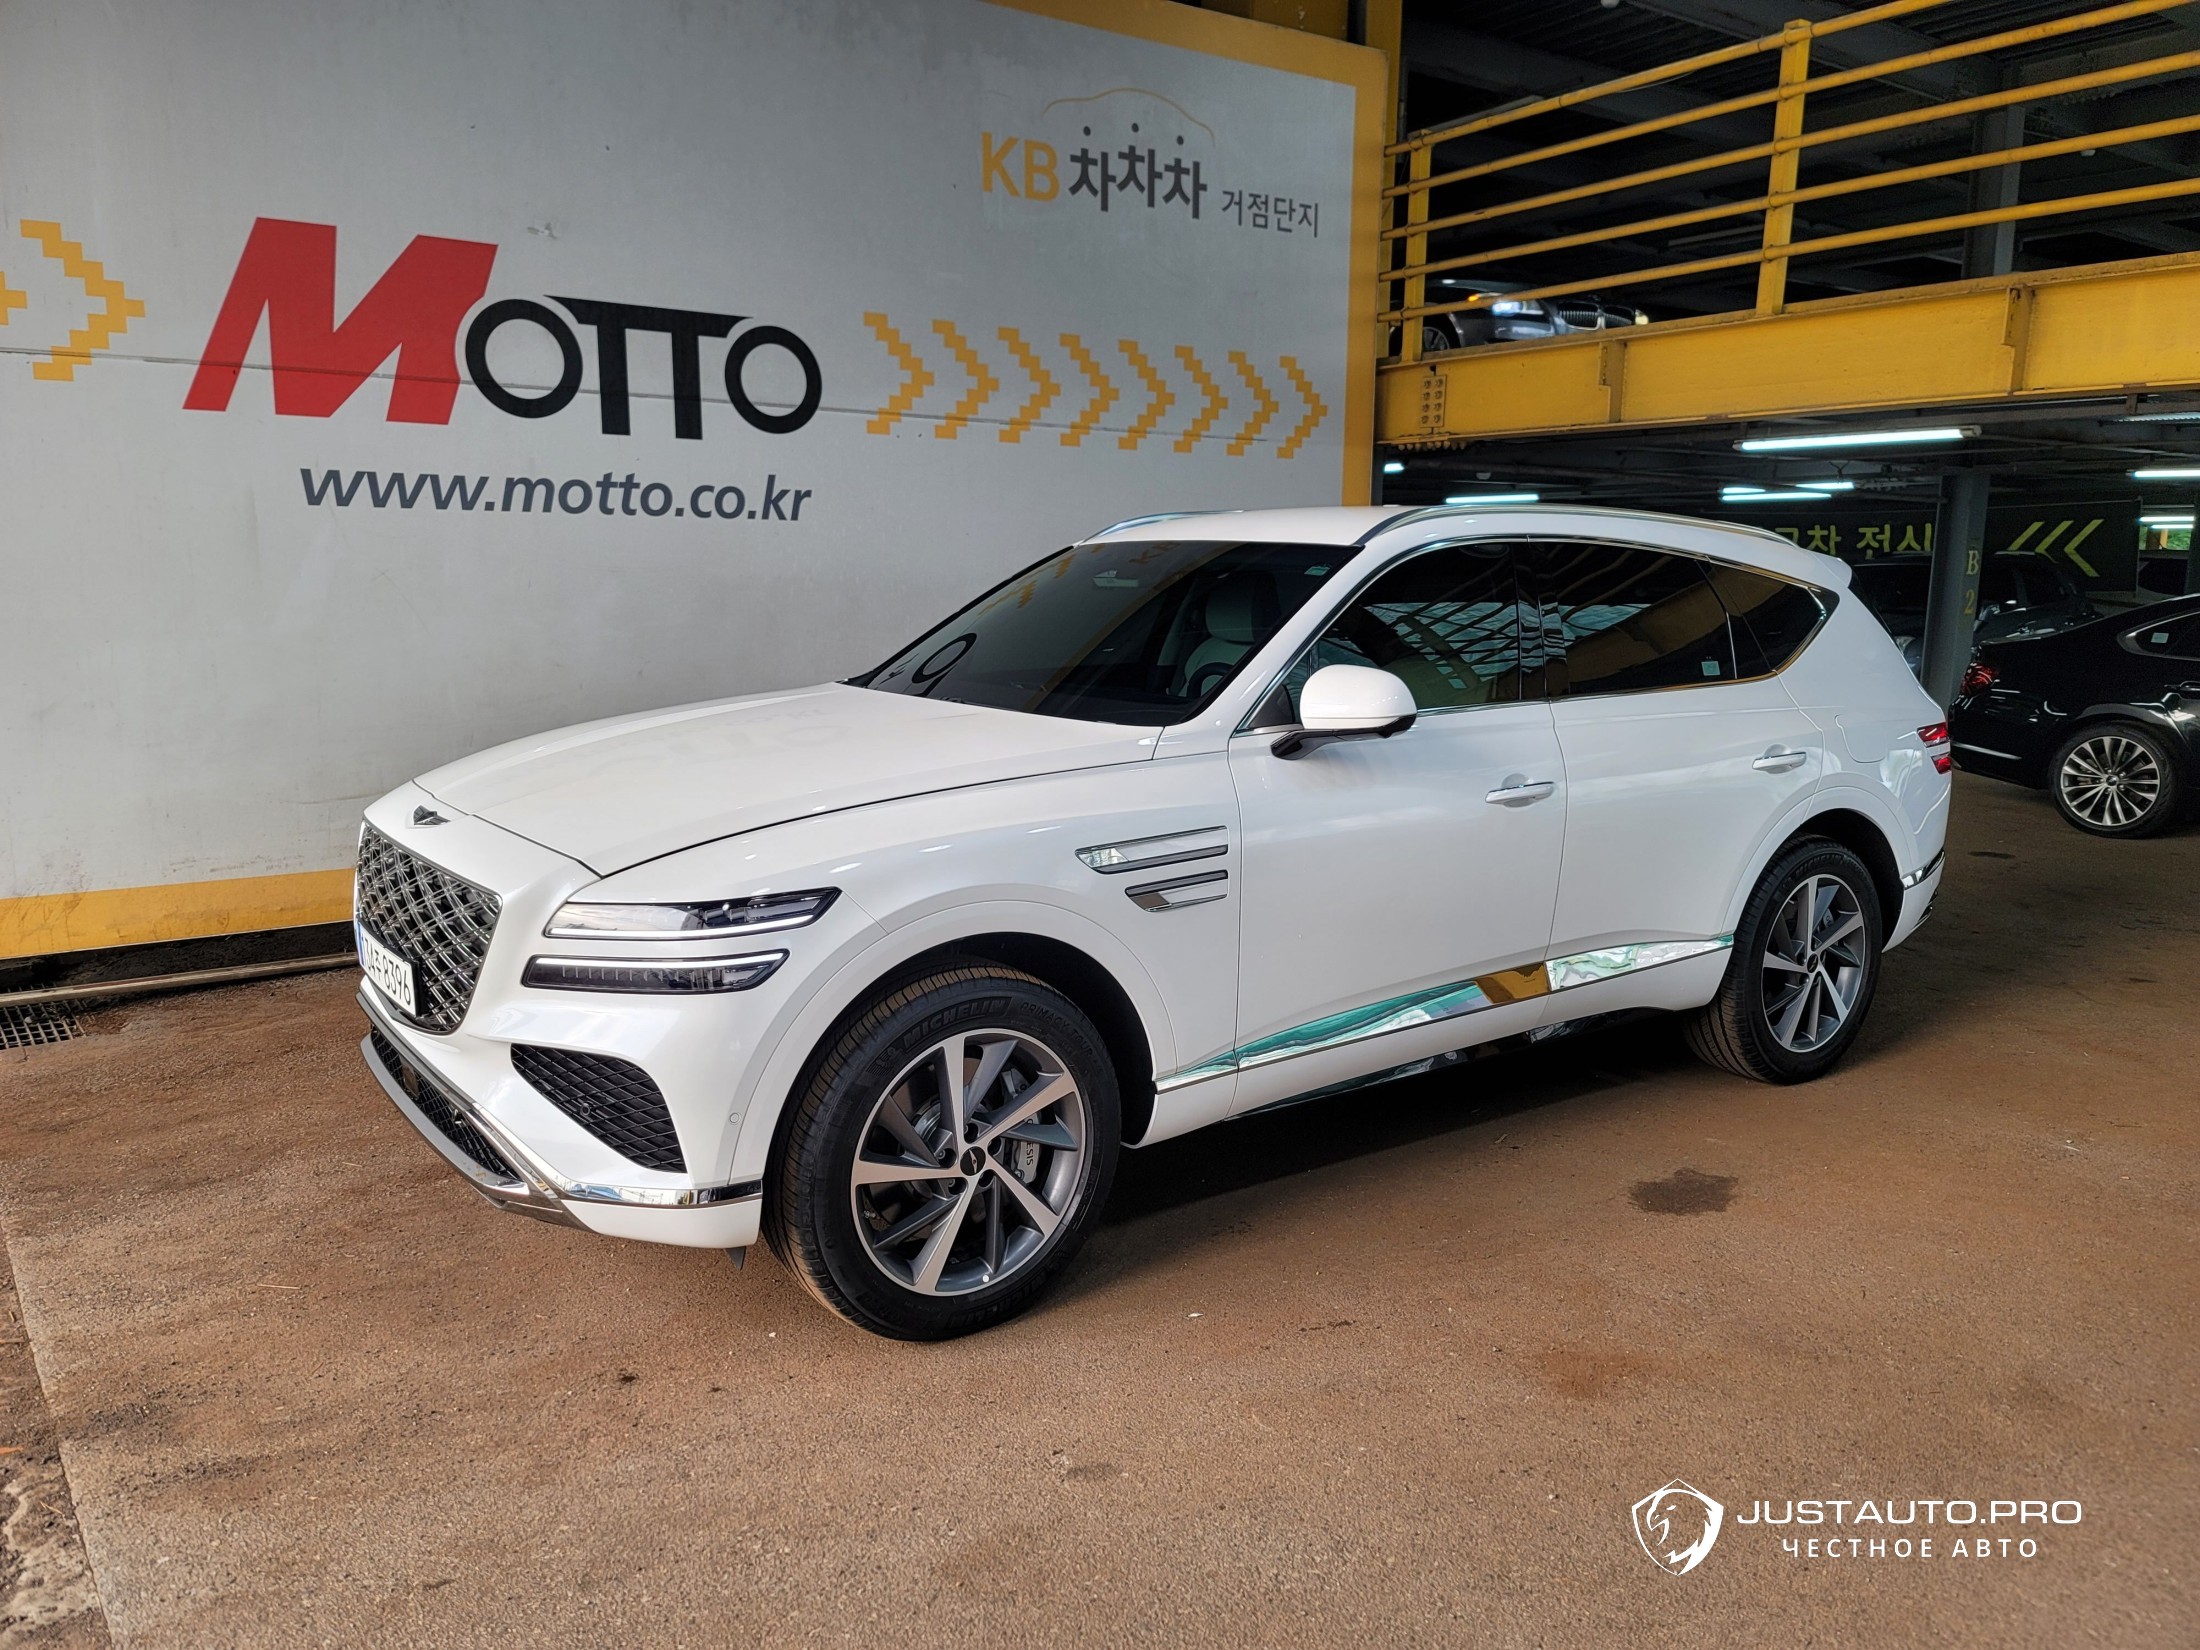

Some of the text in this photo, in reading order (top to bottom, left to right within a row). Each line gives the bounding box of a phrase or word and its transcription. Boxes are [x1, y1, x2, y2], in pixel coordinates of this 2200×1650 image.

[980, 123, 1320, 238] KB 차차차 거점단지
[182, 216, 823, 441] MOTTO
[299, 467, 812, 522] www.motto.co.kr
[1966, 549, 1980, 576] B
[1963, 590, 1975, 615] 2
[903, 1000, 1007, 1047] MICHELIN
